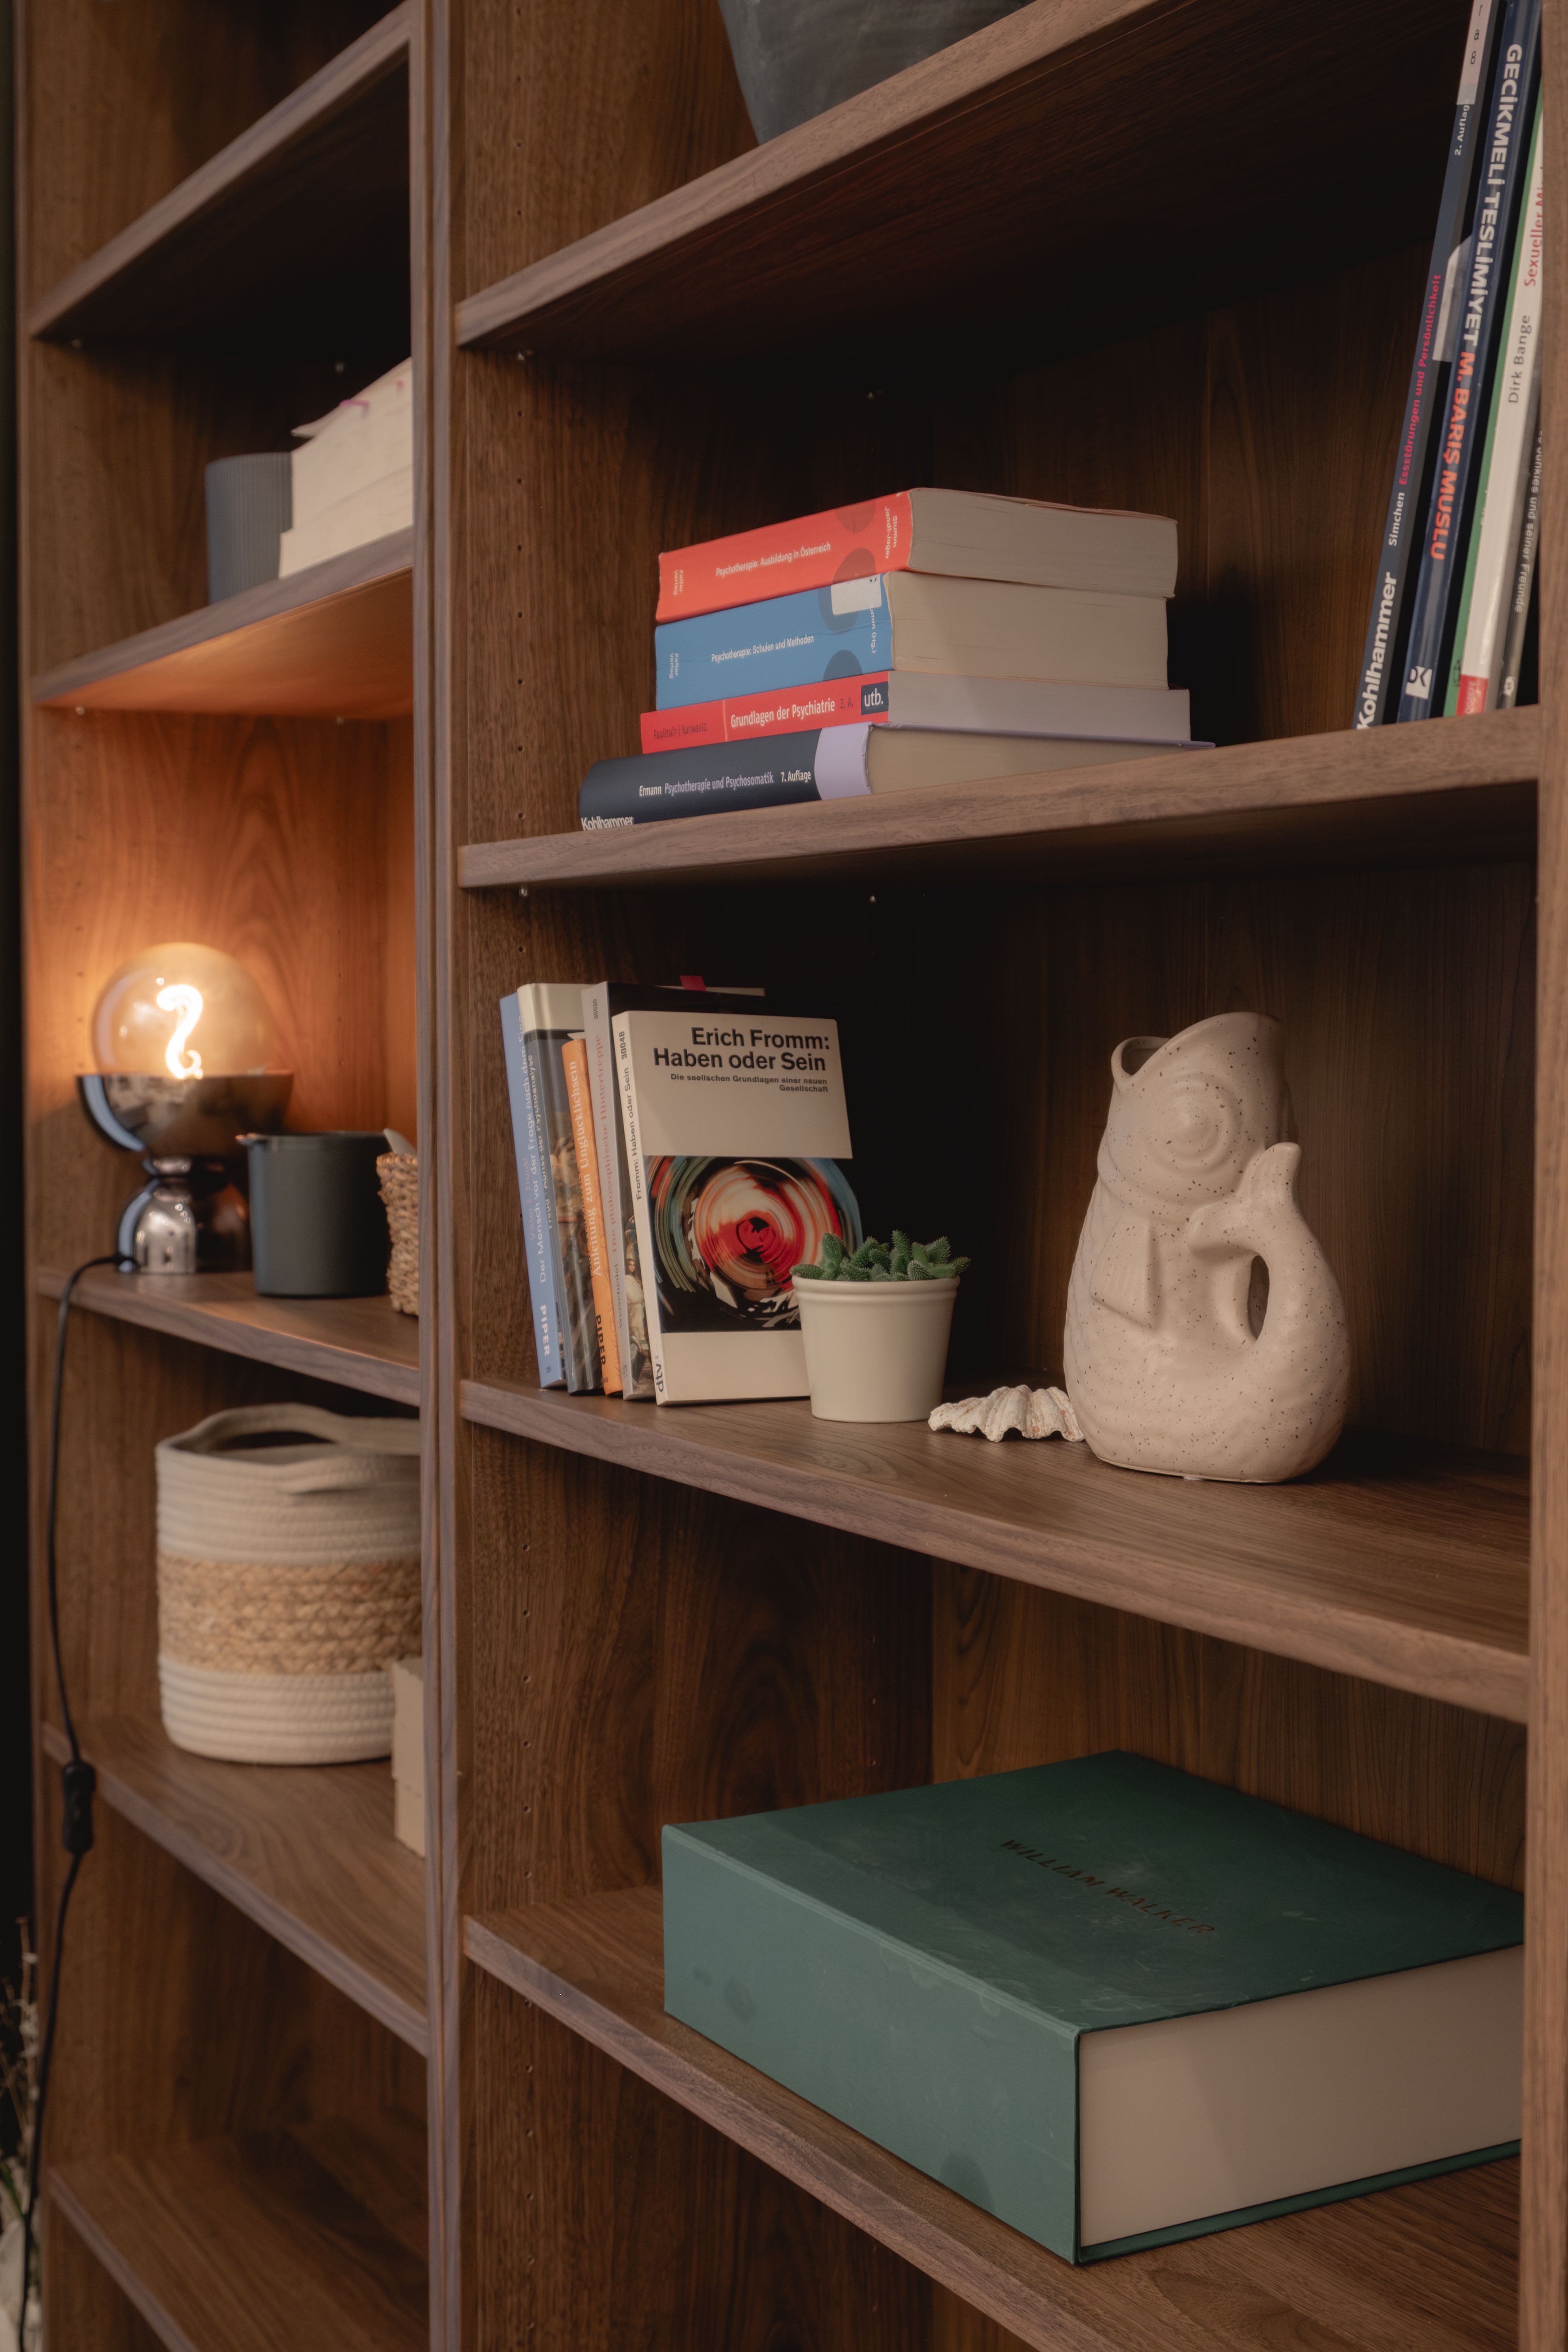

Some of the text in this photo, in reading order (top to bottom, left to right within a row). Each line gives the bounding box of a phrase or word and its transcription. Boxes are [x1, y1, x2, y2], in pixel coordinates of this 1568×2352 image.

[1455, 105, 1470, 156] 2. Auflag
[1524, 212, 1543, 287] Sexueller
[1507, 315, 1533, 404] Dirk Bange
[1388, 273, 1442, 547] Simchen Essstörungen und Persönlichkeit
[1430, 351, 1476, 560] M. BARIŞ MUSLU
[1527, 497, 1537, 520] und
[715, 541, 831, 578] Psychotherapie: Ausbildung in Österreich
[1522, 523, 1534, 561] seiner
[1515, 563, 1530, 614] Freunde
[711, 634, 814, 665] Psychotherapie: Schulen und Methoden
[1356, 571, 1397, 730] Kohlhammer
[682, 722, 707, 734] Karwautz
[730, 710, 774, 729] Grundlagen
[777, 707, 789, 720] der
[792, 697, 835, 720] Psychiatrie
[840, 699, 846, 709] 2.
[864, 688, 884, 707] utb.
[639, 769, 812, 796] Ermann Psychotherapie und Psychosomatik 7. Auflage
[580, 816, 634, 831] Kohlhammer
[619, 1031, 627, 1060] 30048
[691, 1027, 830, 1050] Erich Fromm:
[653, 1047, 826, 1071] Haben oder Sein
[522, 1076, 531, 1109] nach
[687, 1074, 730, 1082] seelischen
[733, 1075, 779, 1084] Grundlagen
[569, 1060, 589, 1169] Unglücklichsein
[583, 1173, 593, 1203] zum
[534, 1202, 544, 1255] Mensch
[586, 1207, 602, 1276] Anleitung
[539, 1304, 550, 1357] PIPER
[595, 1314, 606, 1366] PIPER
[654, 1363, 664, 1393] dtv
[1000, 1840, 1215, 1934] WILLIAM WALKER
